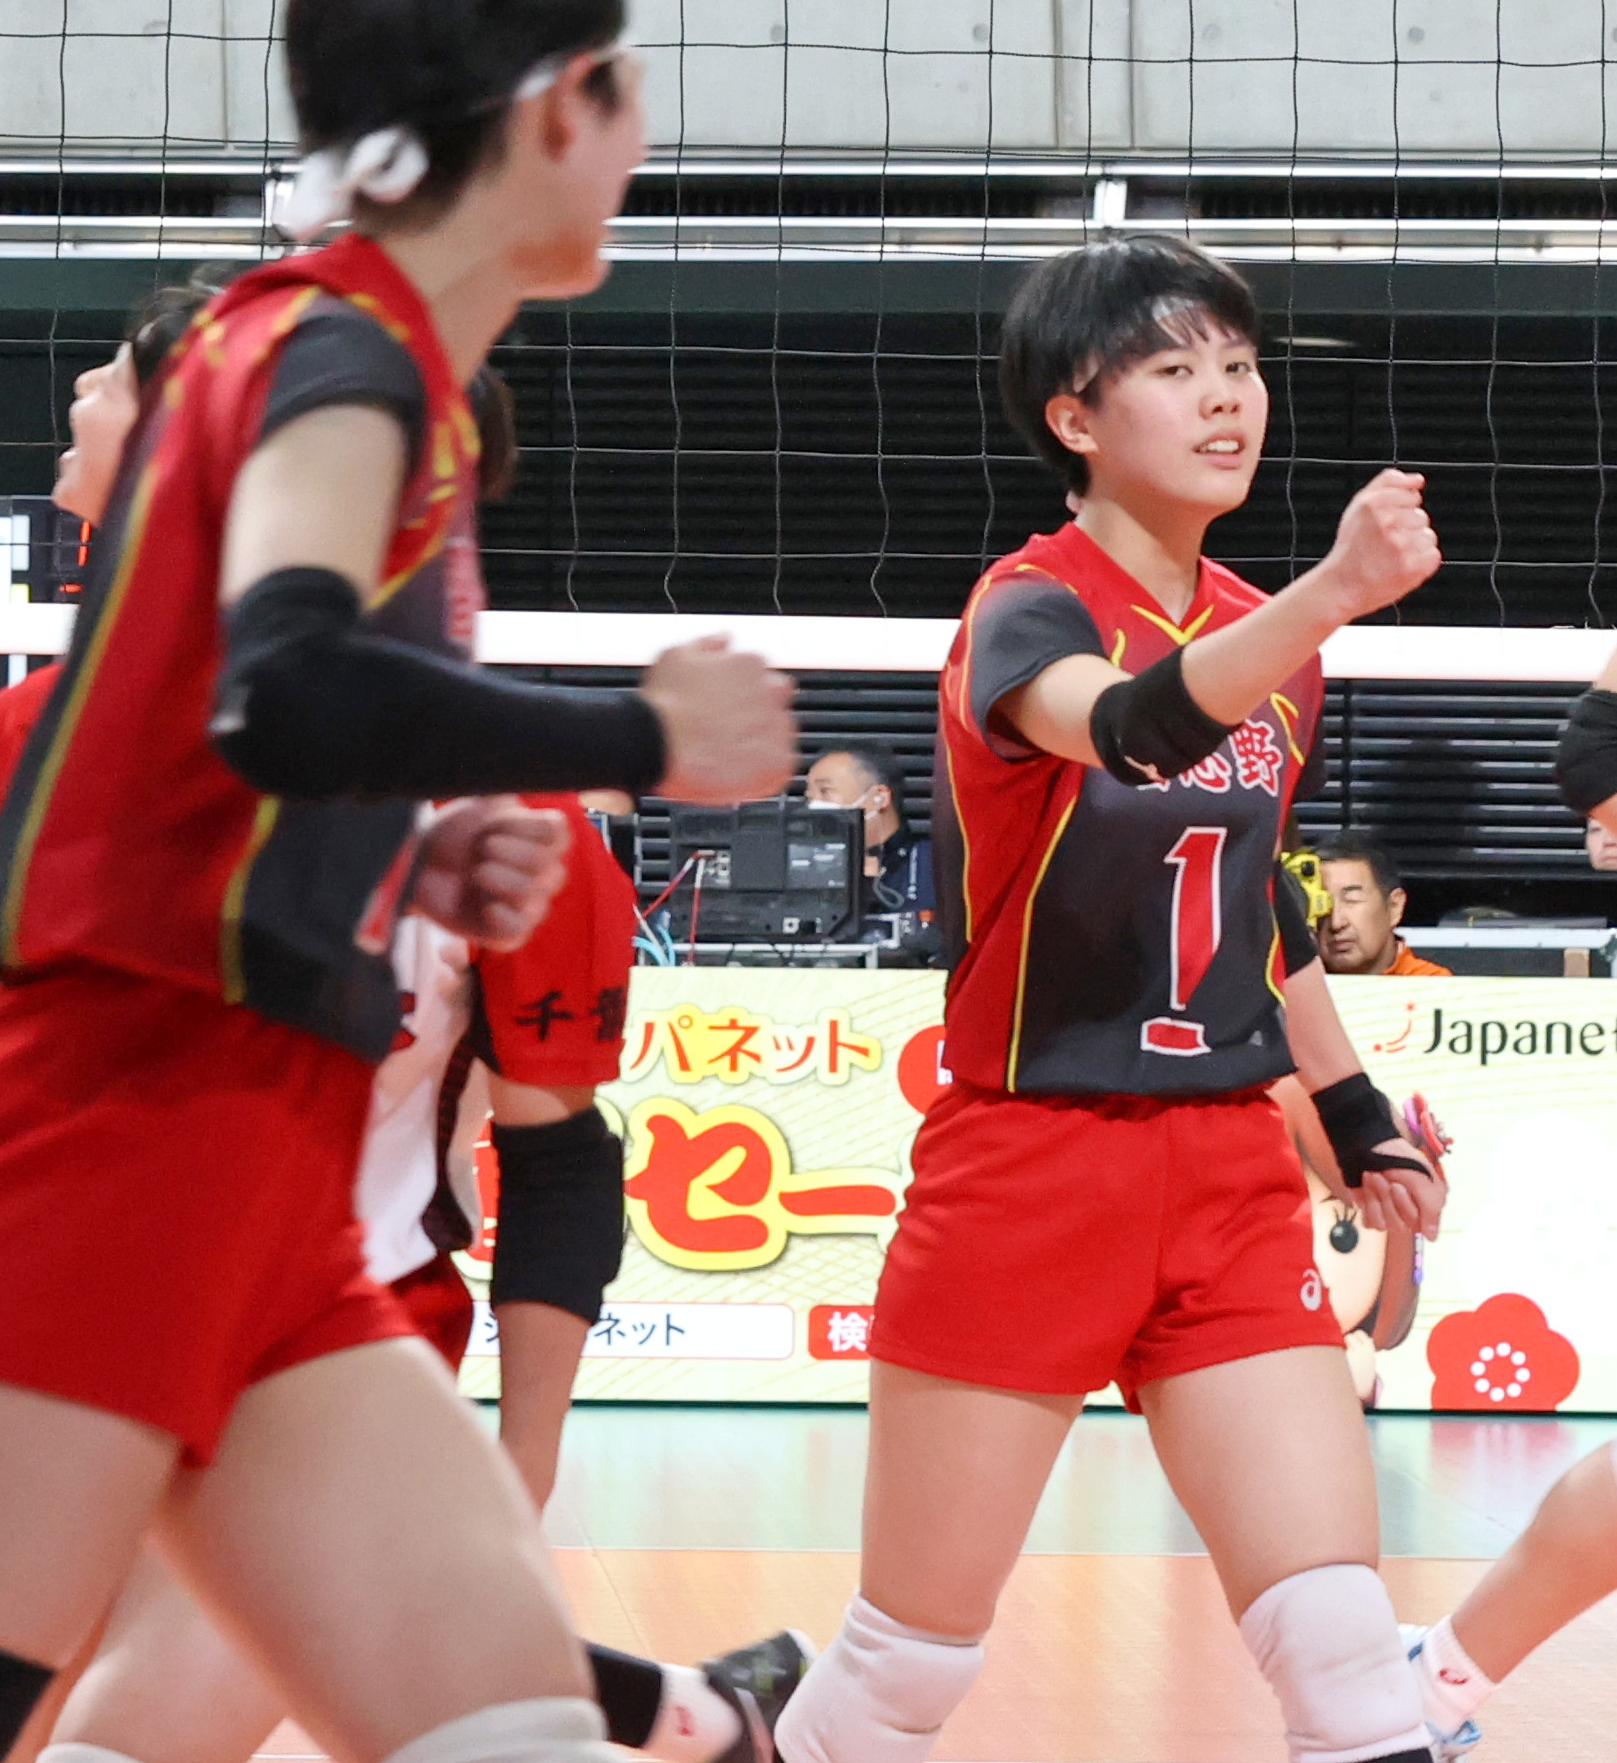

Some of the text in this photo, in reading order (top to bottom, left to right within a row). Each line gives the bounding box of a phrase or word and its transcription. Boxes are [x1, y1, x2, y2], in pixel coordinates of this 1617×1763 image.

[1140, 826, 1228, 1057] 1
[630, 1015, 871, 1074] パネット
